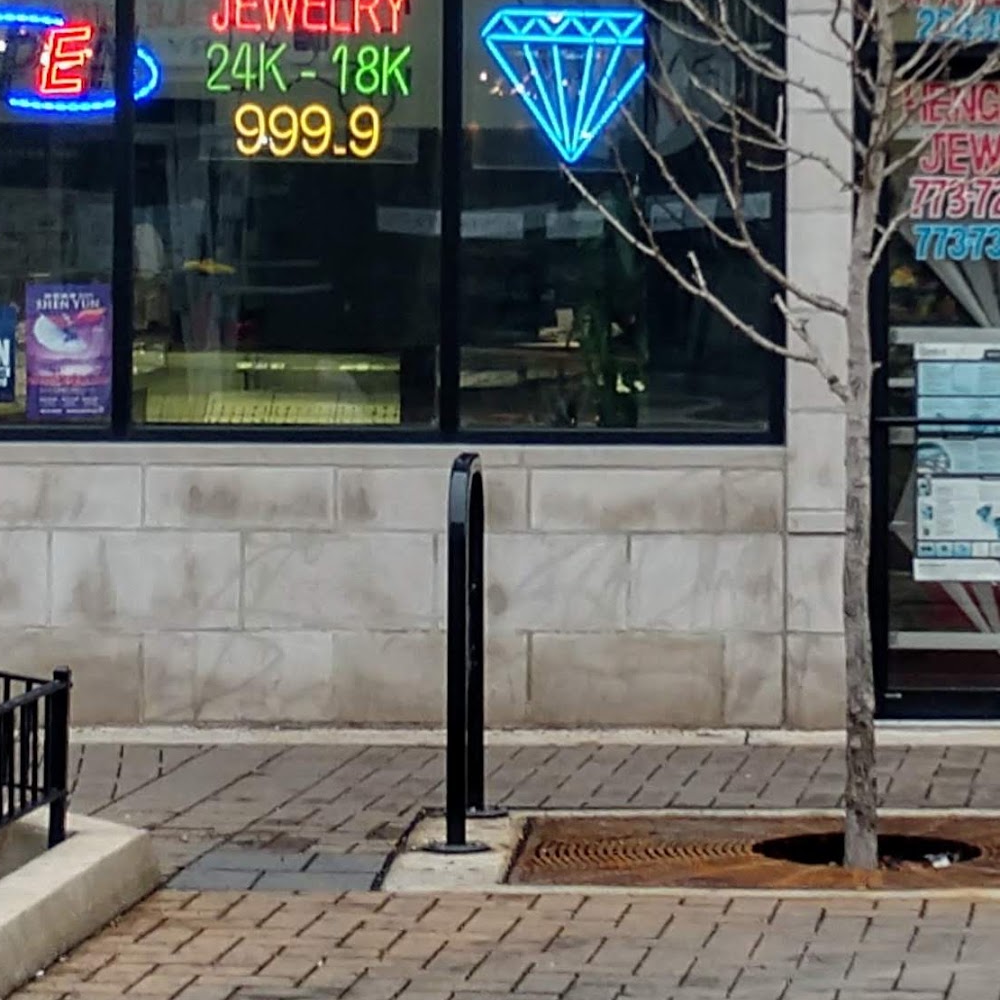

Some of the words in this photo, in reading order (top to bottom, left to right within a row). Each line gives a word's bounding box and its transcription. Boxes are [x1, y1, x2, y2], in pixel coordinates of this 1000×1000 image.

[206, 43, 287, 93] 24K
[331, 43, 412, 97] 18K
[234, 103, 382, 158] 999.9
